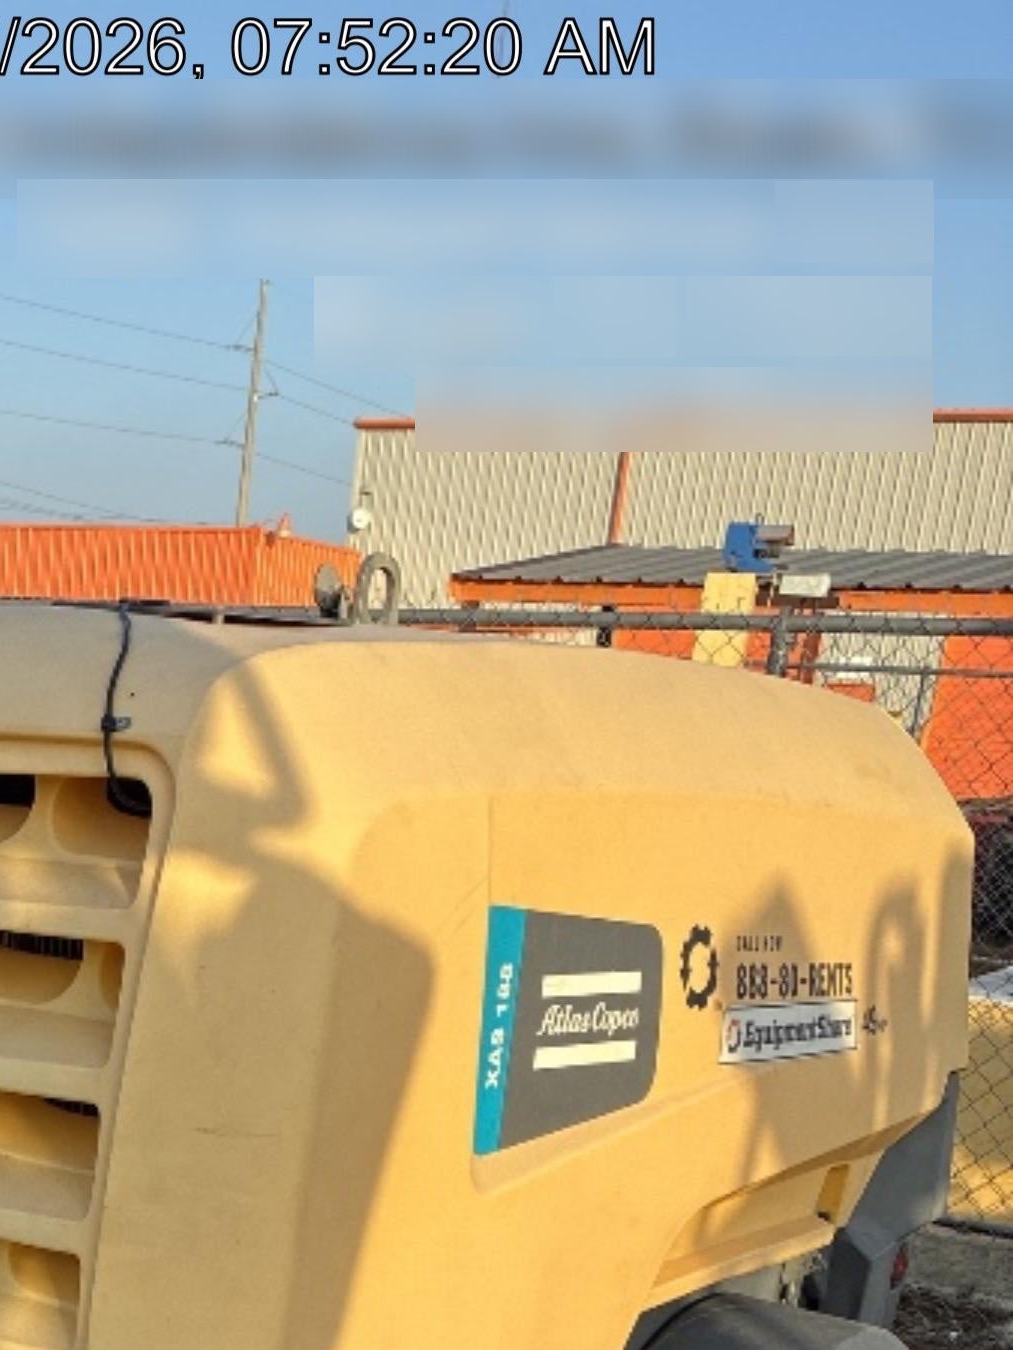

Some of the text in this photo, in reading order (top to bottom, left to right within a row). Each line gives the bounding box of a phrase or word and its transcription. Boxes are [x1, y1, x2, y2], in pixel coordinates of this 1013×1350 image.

[484, 961, 514, 1089] XAS 188
[535, 1000, 640, 1037] Atlas Copco
[743, 1014, 852, 1052] EquipmentShare
